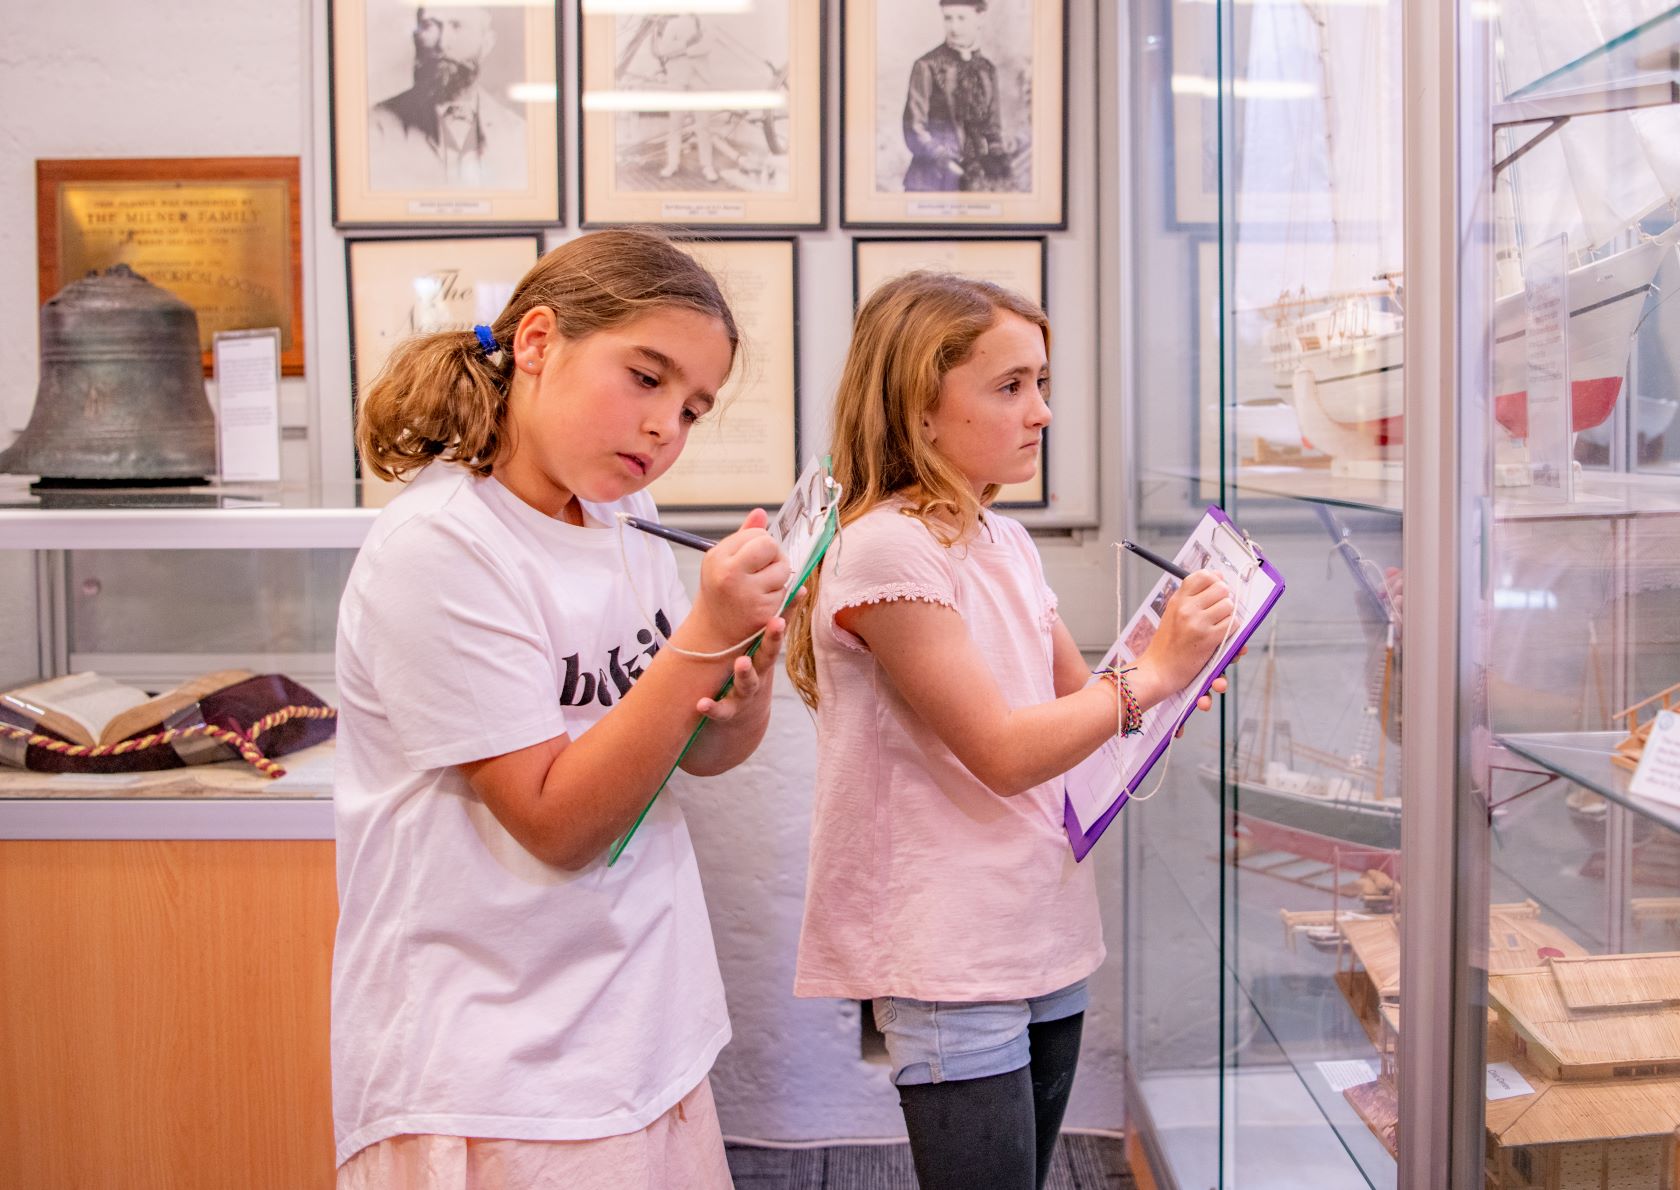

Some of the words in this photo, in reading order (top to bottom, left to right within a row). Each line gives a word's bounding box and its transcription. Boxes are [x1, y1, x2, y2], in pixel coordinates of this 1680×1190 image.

[87, 212, 118, 224] THE
[198, 210, 261, 223] FAMILY
[430, 267, 473, 303] The
